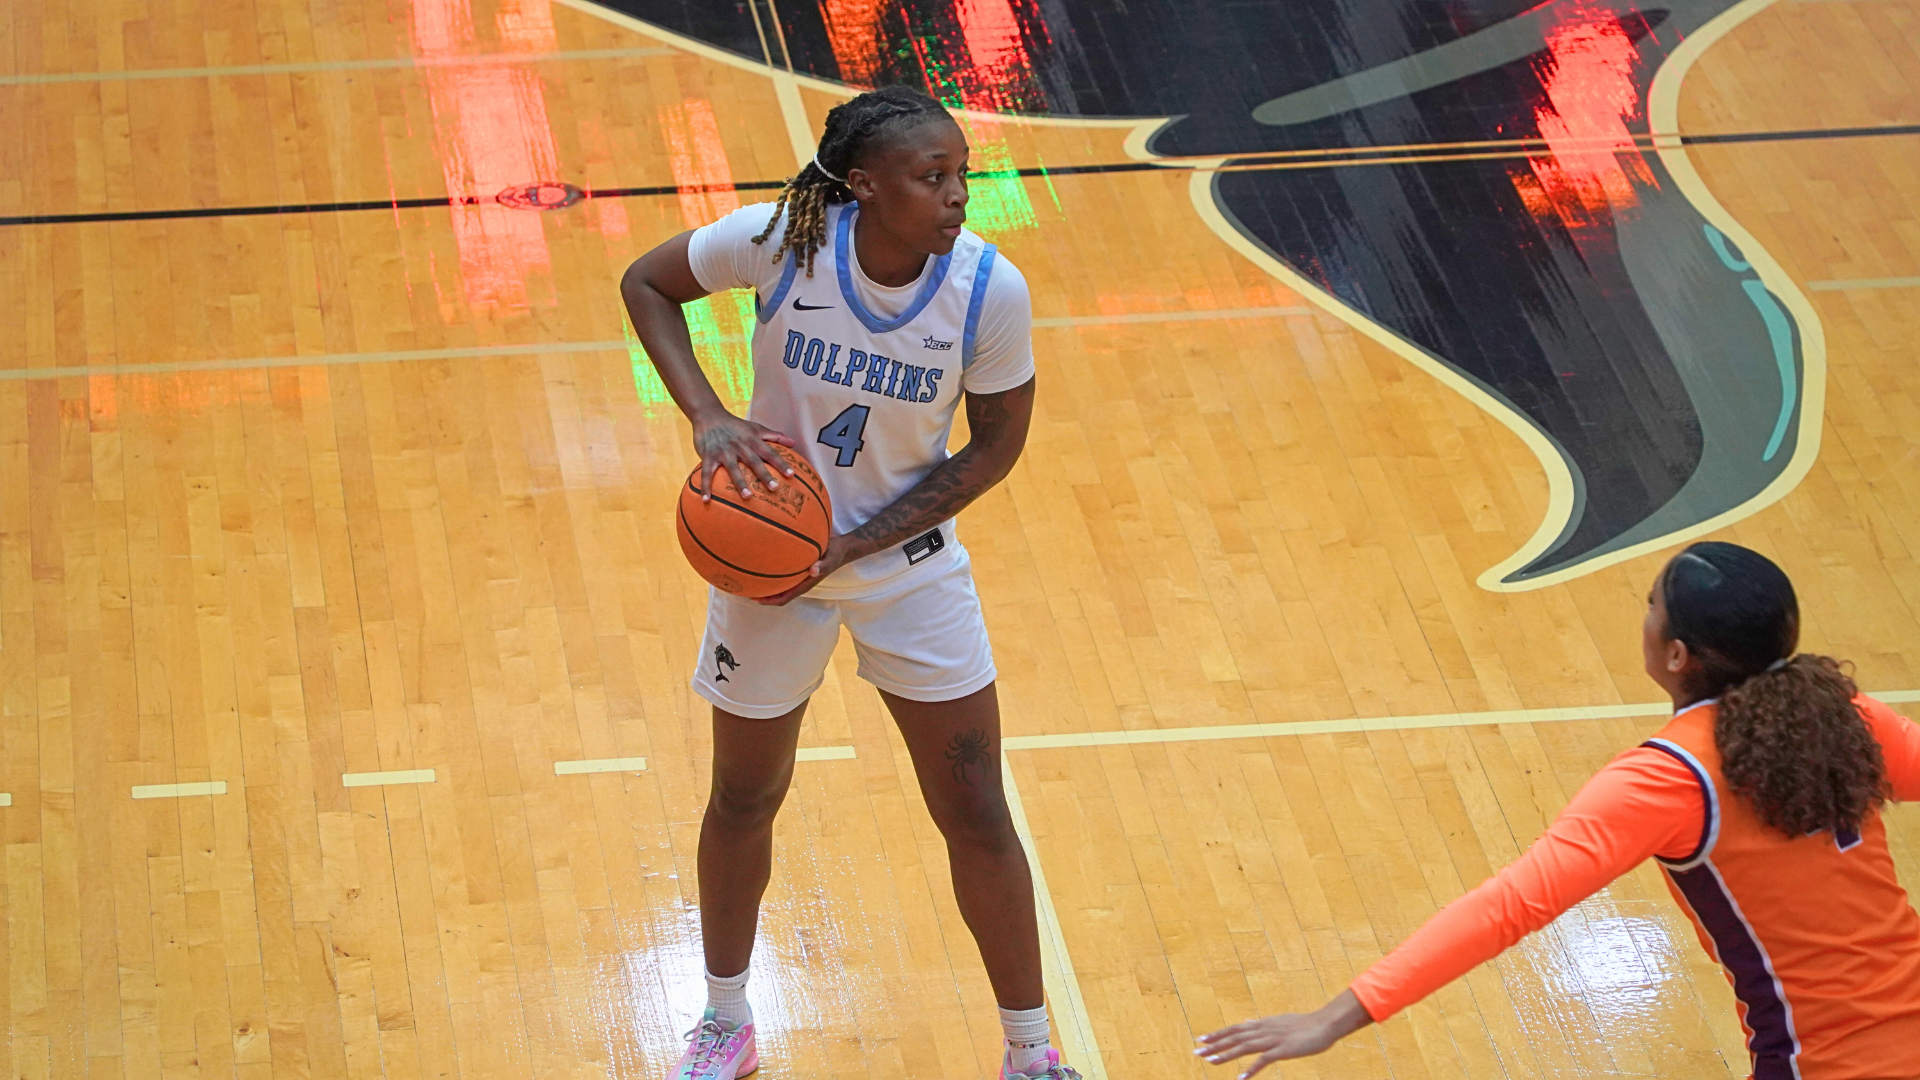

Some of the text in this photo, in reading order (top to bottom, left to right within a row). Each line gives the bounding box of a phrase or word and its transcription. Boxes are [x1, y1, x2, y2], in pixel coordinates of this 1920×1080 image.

[930, 341, 953, 351] ECC
[783, 329, 943, 403] DOLPHINS
[817, 403, 871, 467] 4
[931, 537, 939, 546] L
